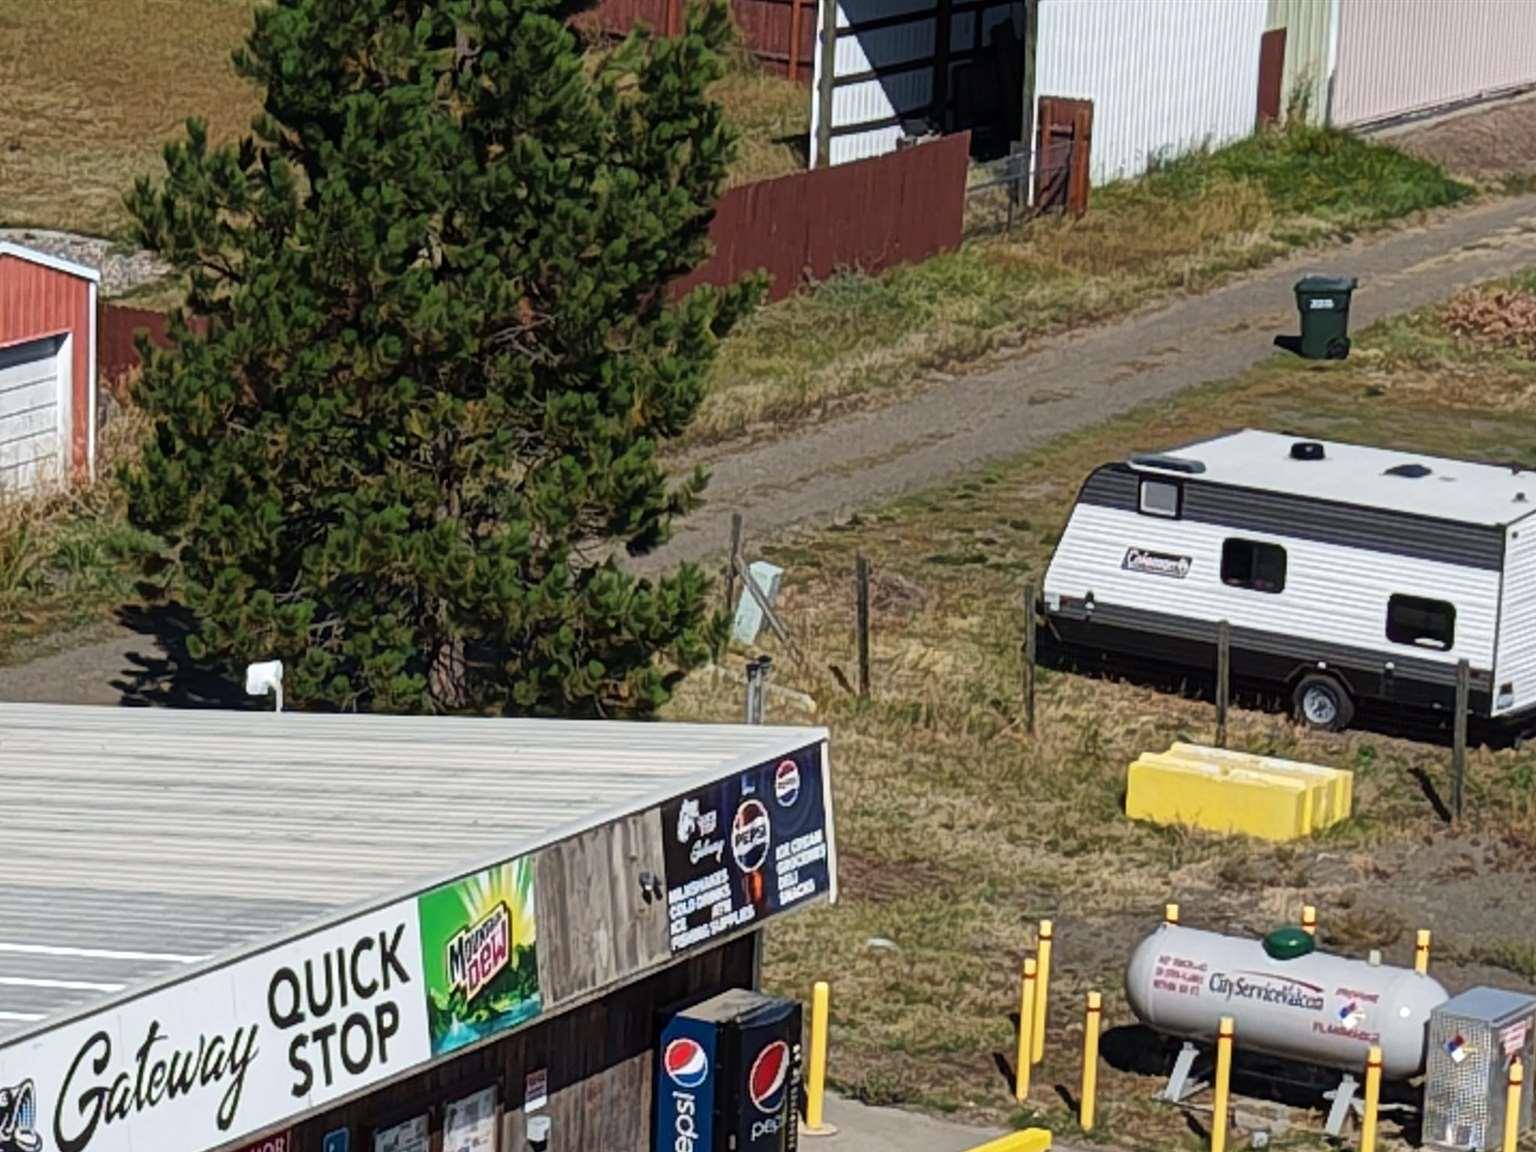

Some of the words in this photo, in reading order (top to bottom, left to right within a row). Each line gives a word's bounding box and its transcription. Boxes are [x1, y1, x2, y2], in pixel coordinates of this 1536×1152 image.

[735, 824, 767, 847] PEPSI
[268, 924, 410, 1030] QUICK
[289, 1001, 400, 1098] STOP
